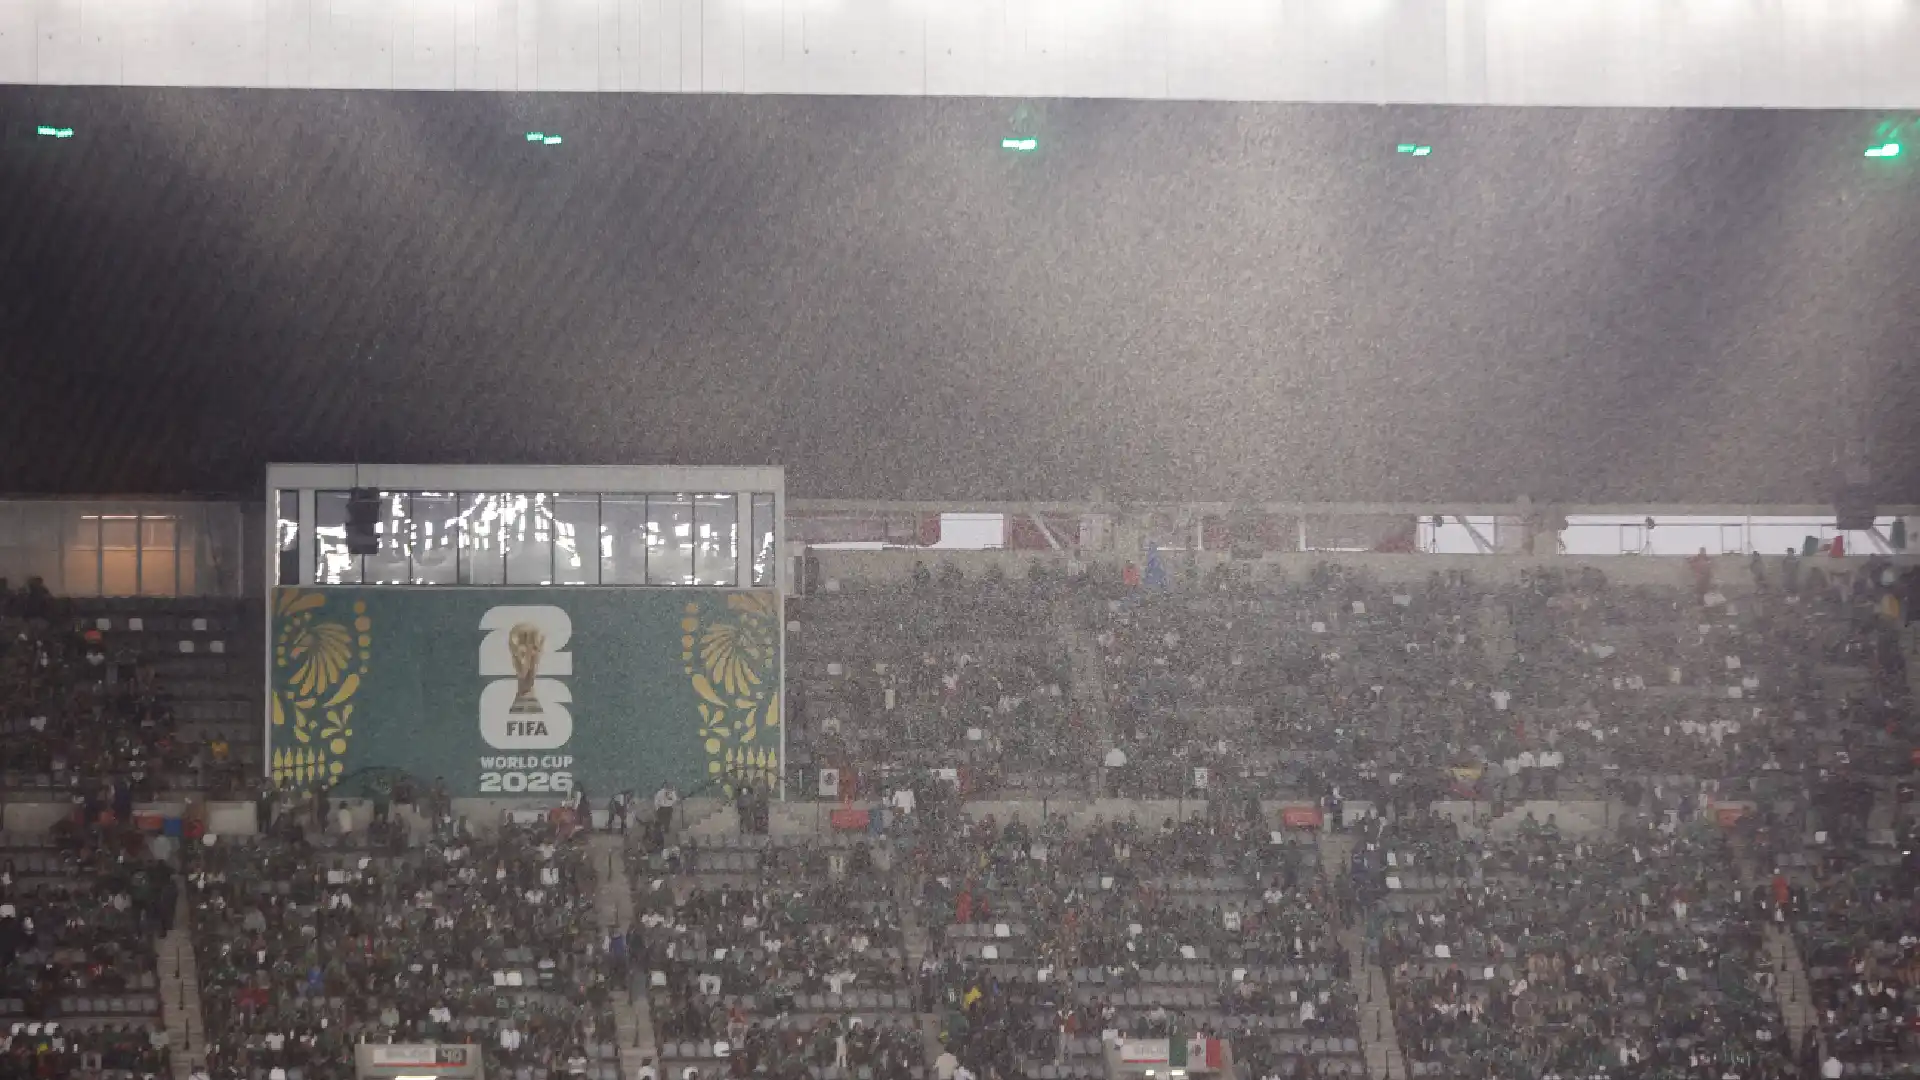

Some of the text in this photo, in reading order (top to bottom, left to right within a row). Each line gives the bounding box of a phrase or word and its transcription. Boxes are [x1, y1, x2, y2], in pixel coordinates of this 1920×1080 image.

[506, 721, 548, 736] FIFA
[480, 756, 573, 769] WORLD CUP
[479, 771, 573, 792] 2026
